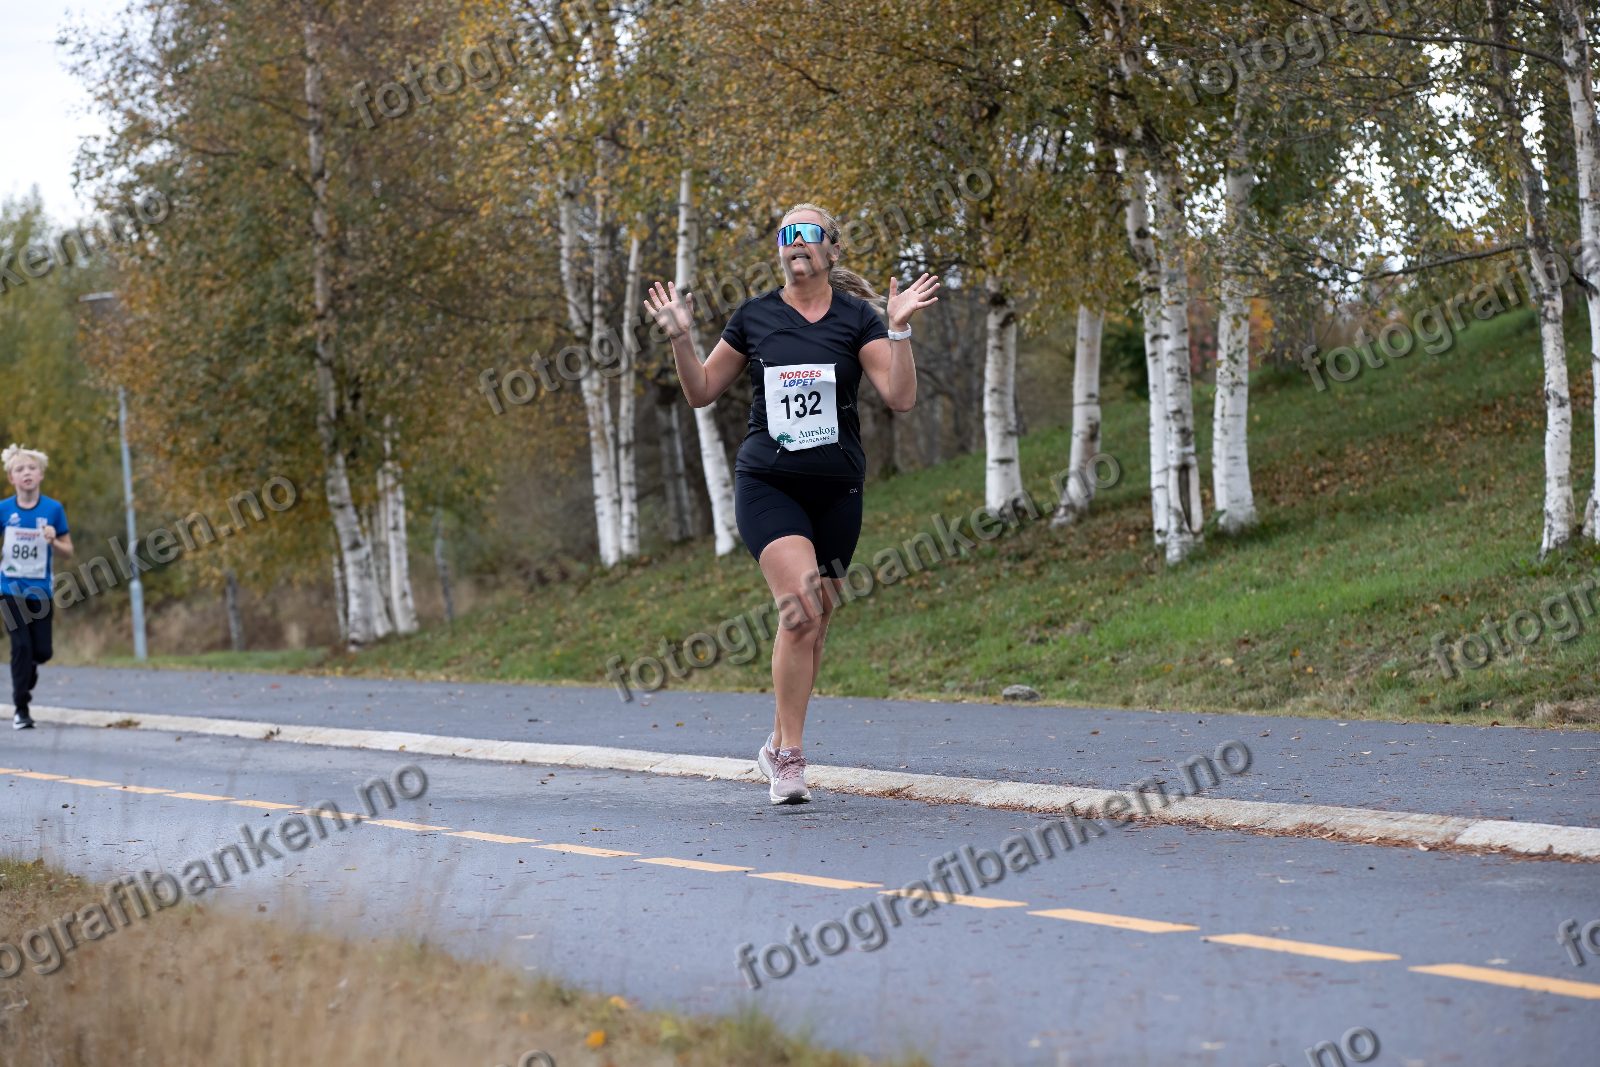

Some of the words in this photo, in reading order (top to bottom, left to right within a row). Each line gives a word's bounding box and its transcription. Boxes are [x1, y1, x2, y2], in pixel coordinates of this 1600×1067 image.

[779, 370, 822, 380] NORGES
[783, 378, 815, 388] LØPET
[780, 391, 822, 420] 132
[799, 426, 836, 439] Aurskog
[12, 544, 38, 559] 984
